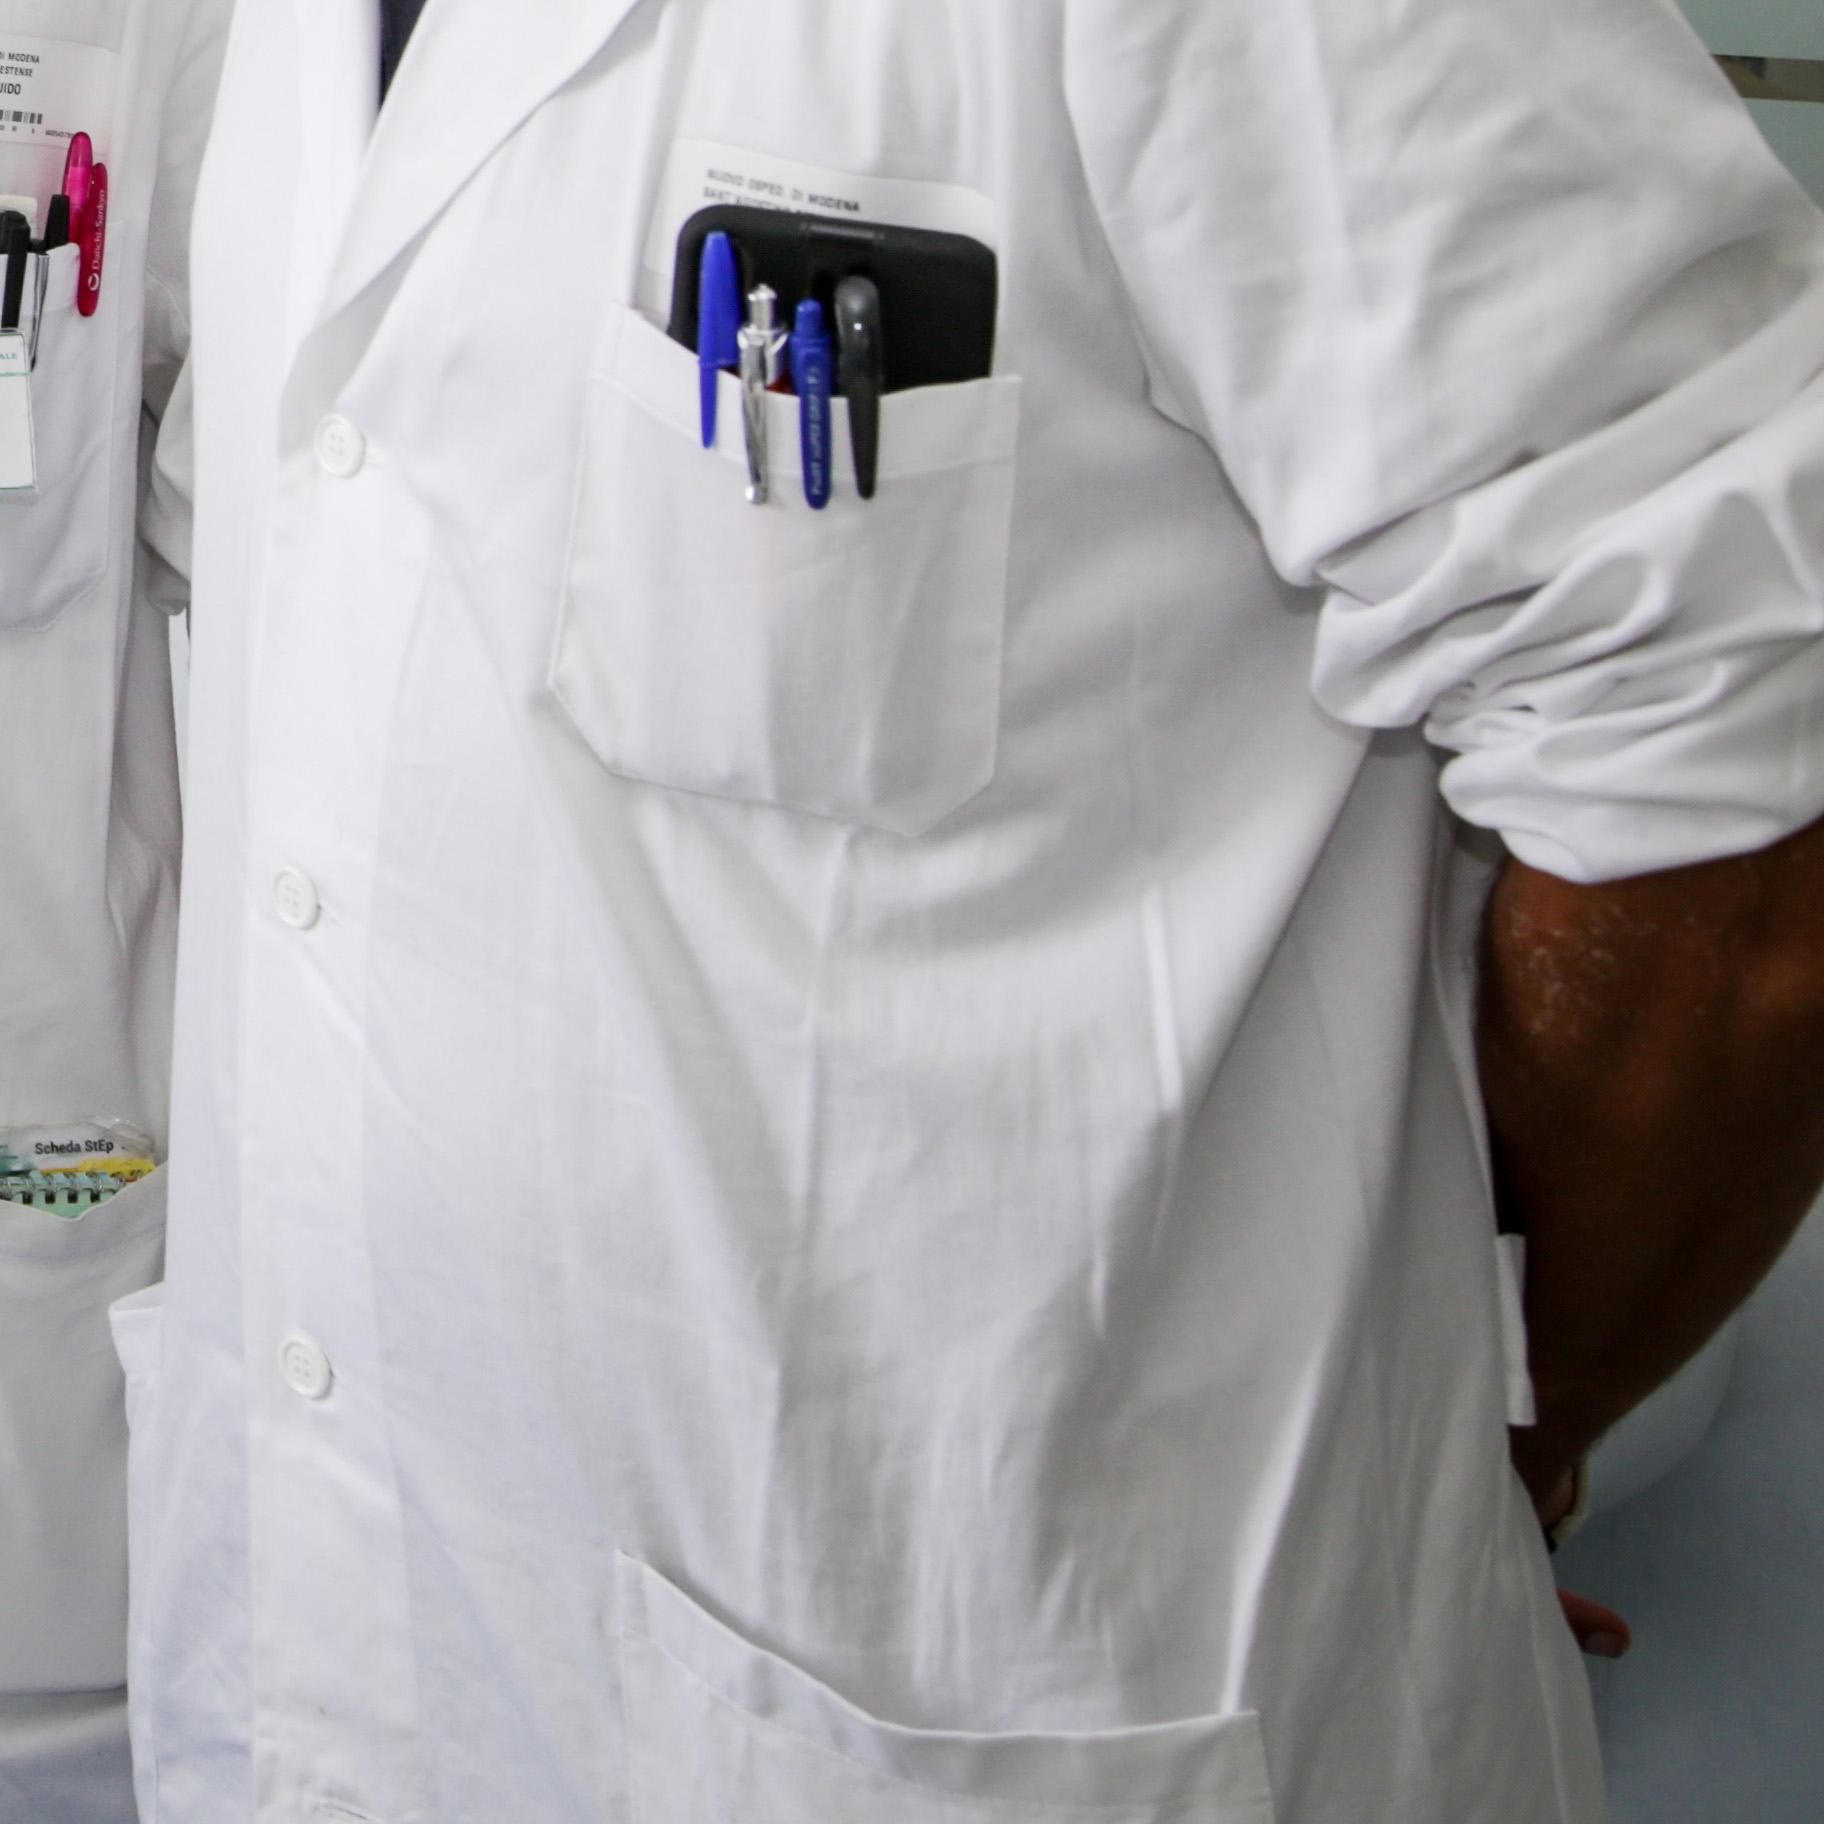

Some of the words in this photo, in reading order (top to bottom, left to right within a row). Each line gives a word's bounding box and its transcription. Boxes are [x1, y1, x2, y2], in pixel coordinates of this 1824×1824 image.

[8, 52, 41, 64] MODENA
[0, 65, 33, 78] ESTENSE
[808, 192, 860, 212] MODENA
[34, 1140, 81, 1155] Scheda
[84, 1138, 115, 1154] StEp
